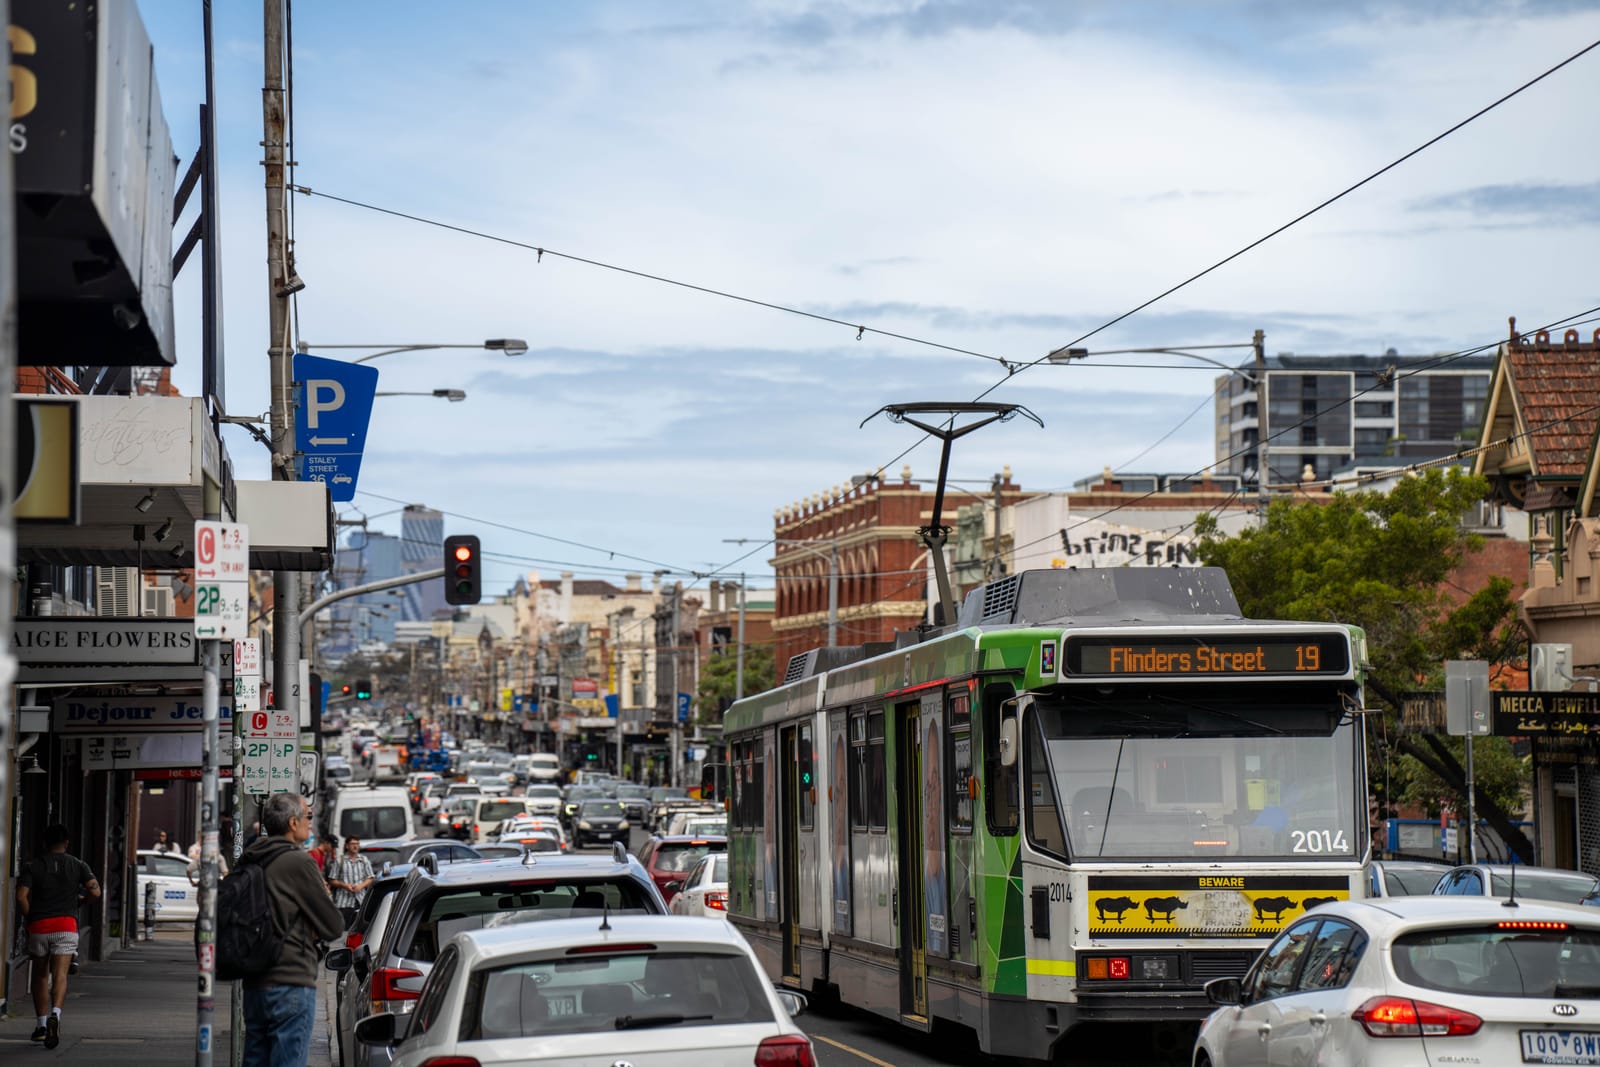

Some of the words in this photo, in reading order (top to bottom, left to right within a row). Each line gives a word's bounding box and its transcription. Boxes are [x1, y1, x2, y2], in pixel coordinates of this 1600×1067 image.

[306, 379, 345, 428] P
[197, 586, 220, 614] 2P
[77, 630, 191, 648] FLOWERS
[1110, 647, 1191, 672] Flinders
[1196, 646, 1266, 672] Street
[1295, 645, 1320, 671] 19
[292, 684, 300, 697] 2
[67, 702, 156, 724] Dejour
[170, 702, 233, 720] Jen
[1500, 697, 1544, 713] MECCA
[248, 743, 269, 757] 2P
[1291, 830, 1349, 853] 2014
[1050, 882, 1072, 903] 2014
[1199, 877, 1245, 888] BEWARE
[1555, 1004, 1574, 1014] KIA
[1573, 1036, 1600, 1056] 8W
